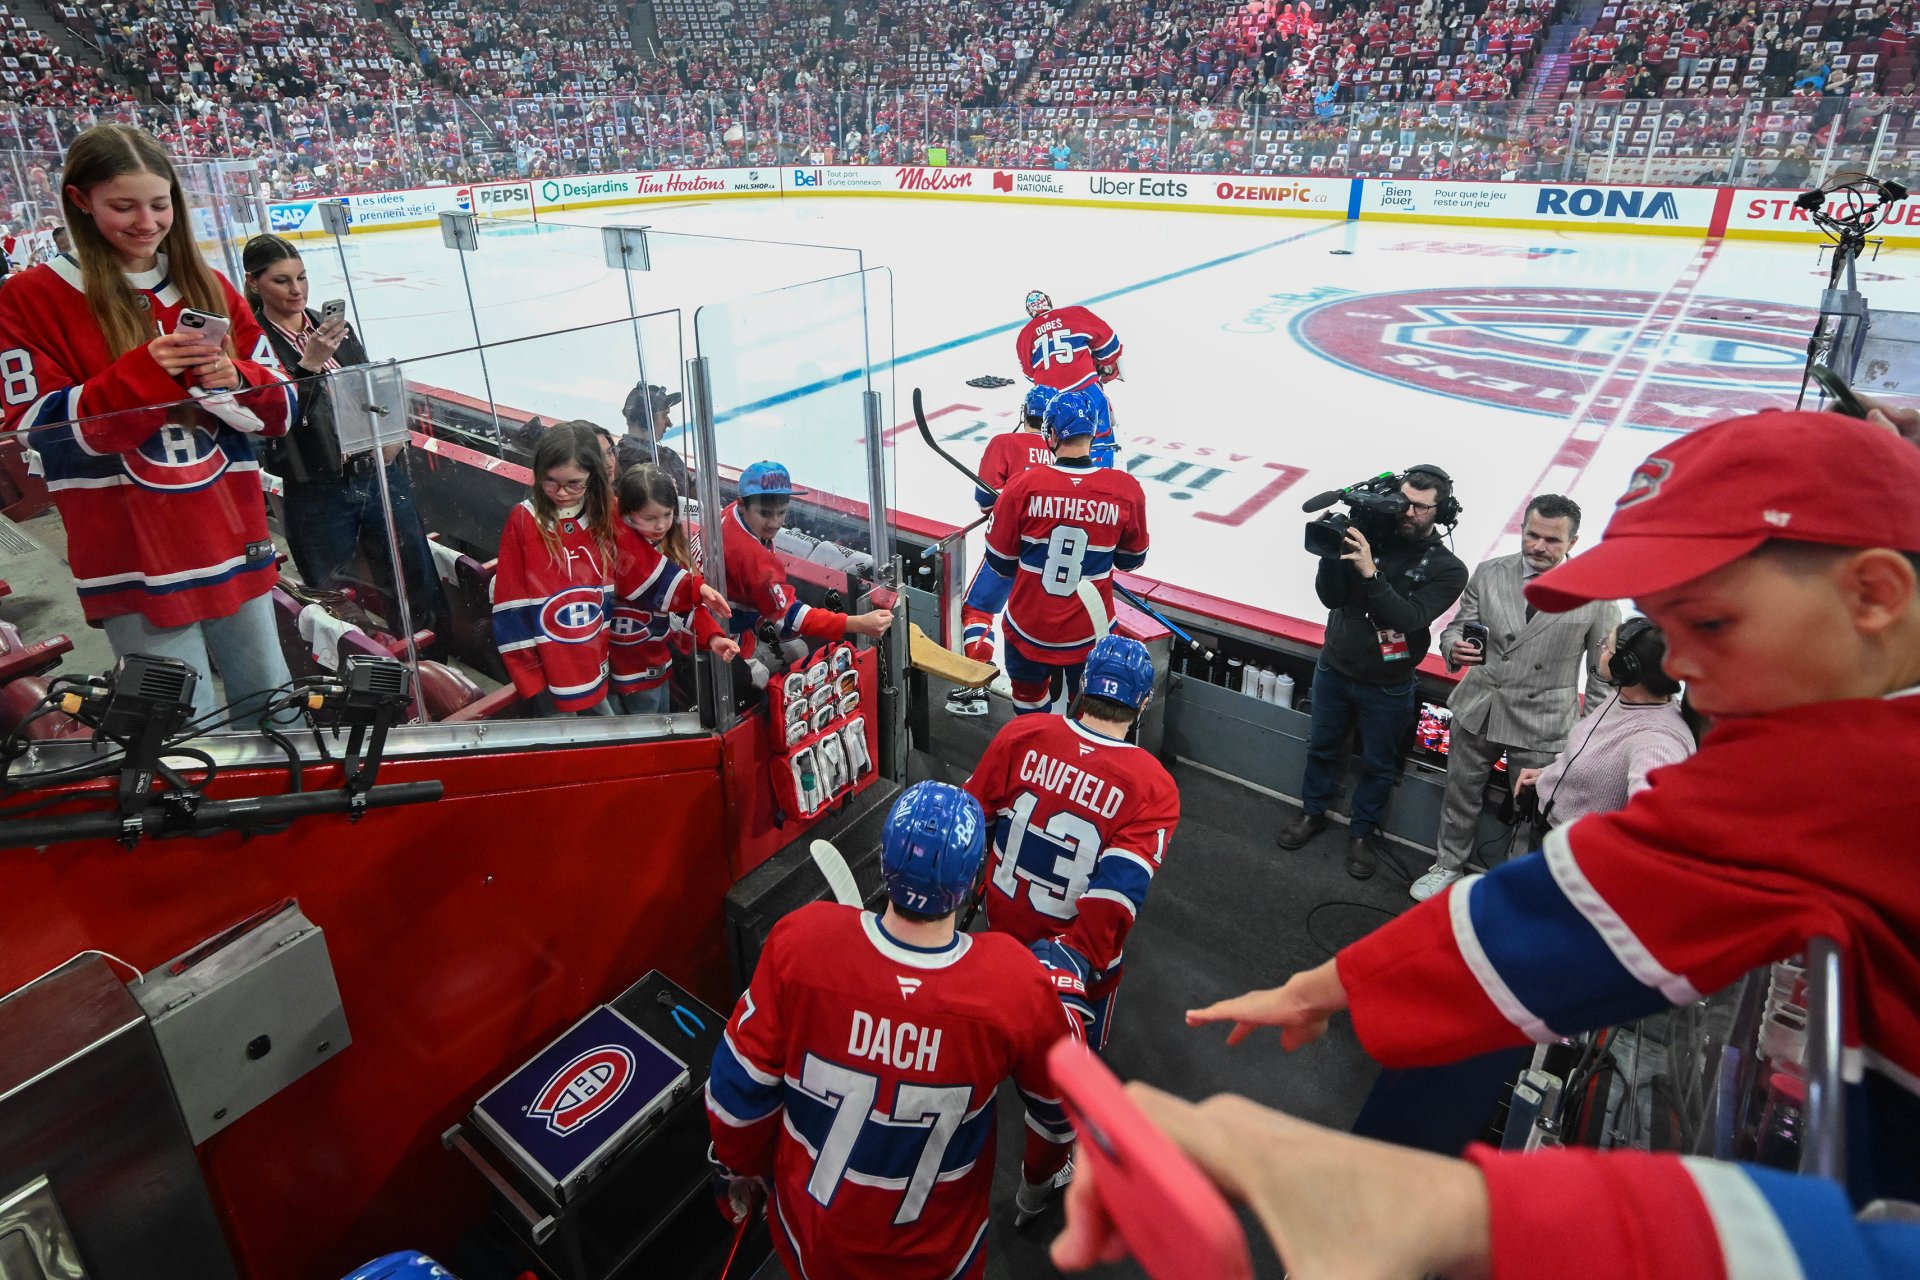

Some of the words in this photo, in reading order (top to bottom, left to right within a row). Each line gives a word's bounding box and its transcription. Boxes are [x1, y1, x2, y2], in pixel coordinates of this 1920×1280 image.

[635, 175, 663, 194] Tim
[667, 173, 725, 193] Hortons
[794, 169, 823, 187] Bell
[827, 170, 845, 178] Tout
[848, 170, 859, 180] part
[895, 167, 972, 190] Molson
[1017, 174, 1052, 183] BANQUE
[480, 188, 529, 204] PEPSI
[563, 180, 629, 198] Desjardins
[1017, 184, 1063, 193] NATIONALE
[1089, 177, 1135, 195] Uber
[1139, 178, 1188, 198] Eats
[1385, 187, 1412, 197] Bien
[1435, 189, 1457, 198] Pour
[1459, 191, 1478, 199] que
[1480, 191, 1489, 199] le
[1490, 193, 1507, 201] jeu
[356, 197, 375, 206] Les
[377, 194, 405, 204] idées
[1381, 195, 1412, 206] jouer
[1433, 199, 1458, 207] reste
[1474, 200, 1490, 209] jeu
[1536, 188, 1680, 220] RONA
[270, 208, 306, 226] SAP
[359, 208, 406, 222] prennent
[424, 203, 436, 213] ici
[251, 334, 281, 368] 4
[1034, 329, 1074, 370] 75
[0, 348, 39, 406] 8
[1028, 496, 1119, 526] MATHESON
[1041, 525, 1089, 597] 8
[1103, 681, 1119, 694] 13
[1020, 750, 1125, 820] CAUFIELD
[954, 805, 976, 846] Bell
[992, 791, 1103, 921] 13
[1153, 828, 1171, 864] 1
[906, 891, 928, 909] 77
[847, 1009, 942, 1072] DACH
[800, 1051, 974, 1226] 77
